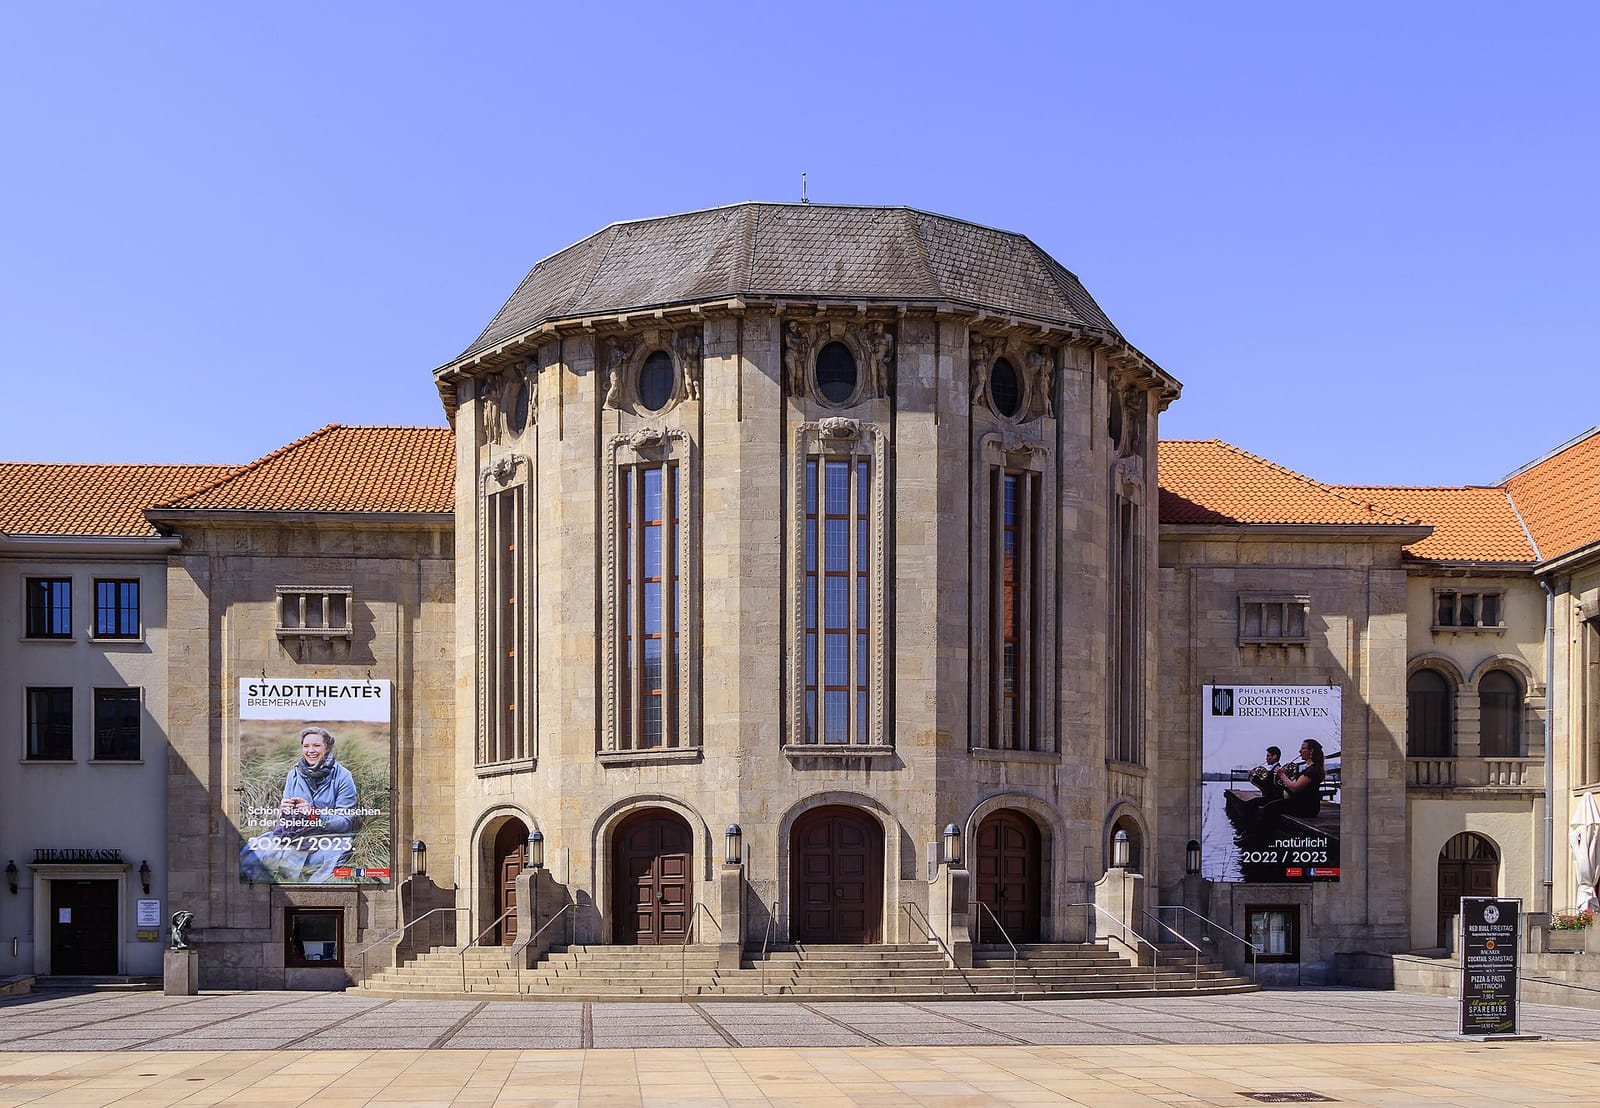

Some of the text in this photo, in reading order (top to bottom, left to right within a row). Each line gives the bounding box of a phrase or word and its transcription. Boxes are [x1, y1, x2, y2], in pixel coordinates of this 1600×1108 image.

[248, 685, 382, 698] STADTTHEATER
[248, 698, 326, 707] BREMERHAVEN
[1238, 696, 1310, 706] ORCHESTER
[1238, 707, 1329, 717] BREMERHAVEN
[284, 807, 298, 816] Sie
[300, 807, 381, 816] wiederzusehen
[248, 818, 254, 827] in
[259, 818, 277, 827] der
[248, 836, 356, 851] 2022 / 2023.
[32, 848, 122, 861] THEATERKASSE
[1243, 851, 1328, 863] 2022 / 2023
